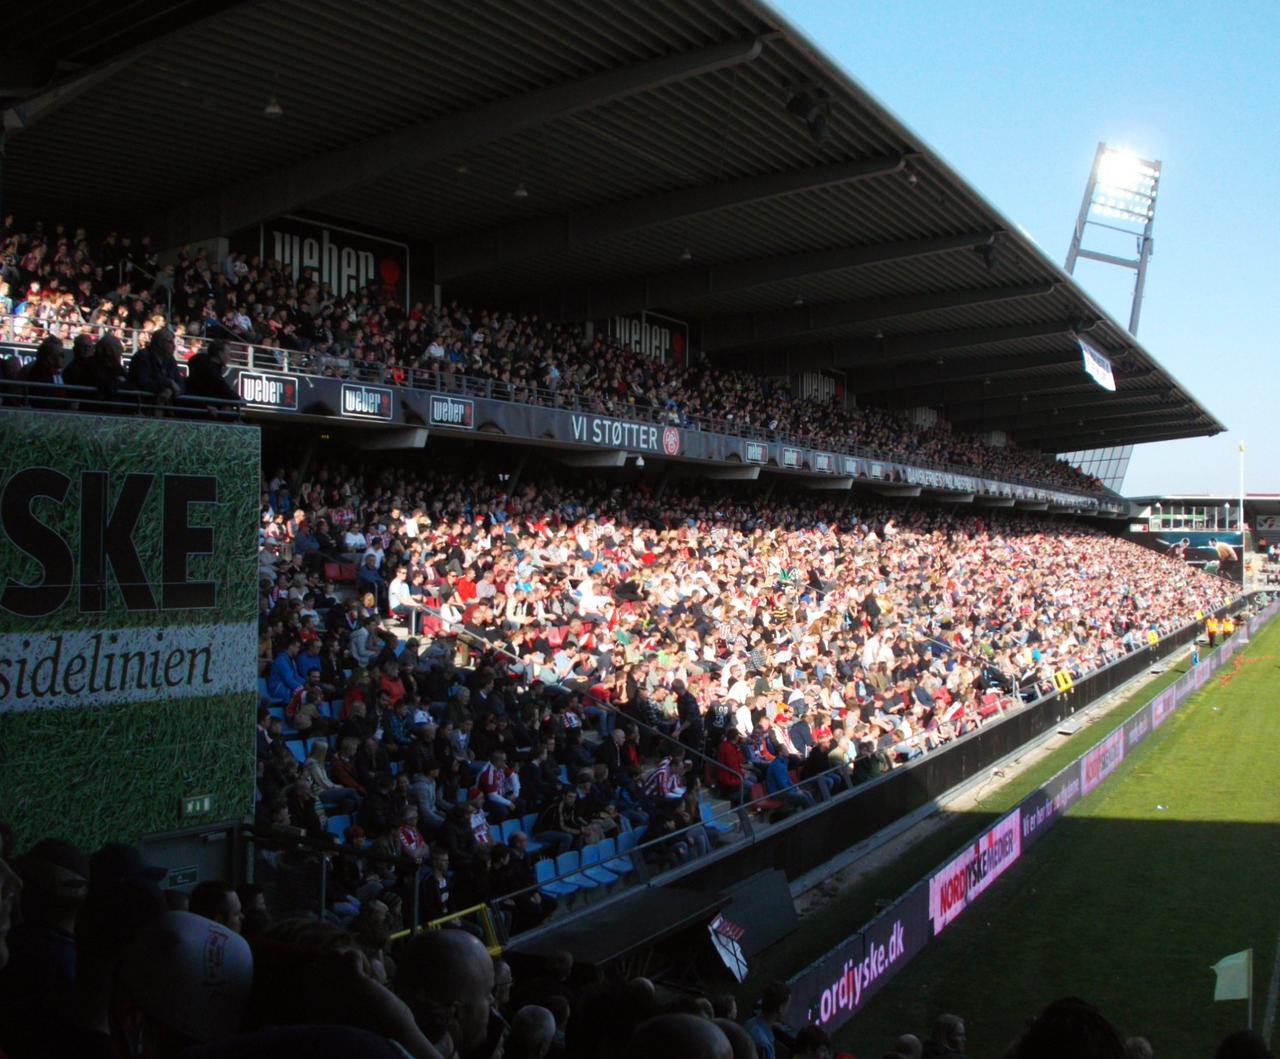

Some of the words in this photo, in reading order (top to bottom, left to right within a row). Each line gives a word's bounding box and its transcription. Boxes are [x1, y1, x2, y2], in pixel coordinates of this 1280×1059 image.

[272, 229, 375, 299] weber
[243, 376, 284, 403] weber
[345, 388, 381, 414] weber
[433, 399, 465, 423] weber
[571, 415, 587, 441] VI
[592, 418, 657, 449] STØTTER
[0, 466, 217, 617] SKE
[808, 919, 905, 1025] ordjyske.dk
